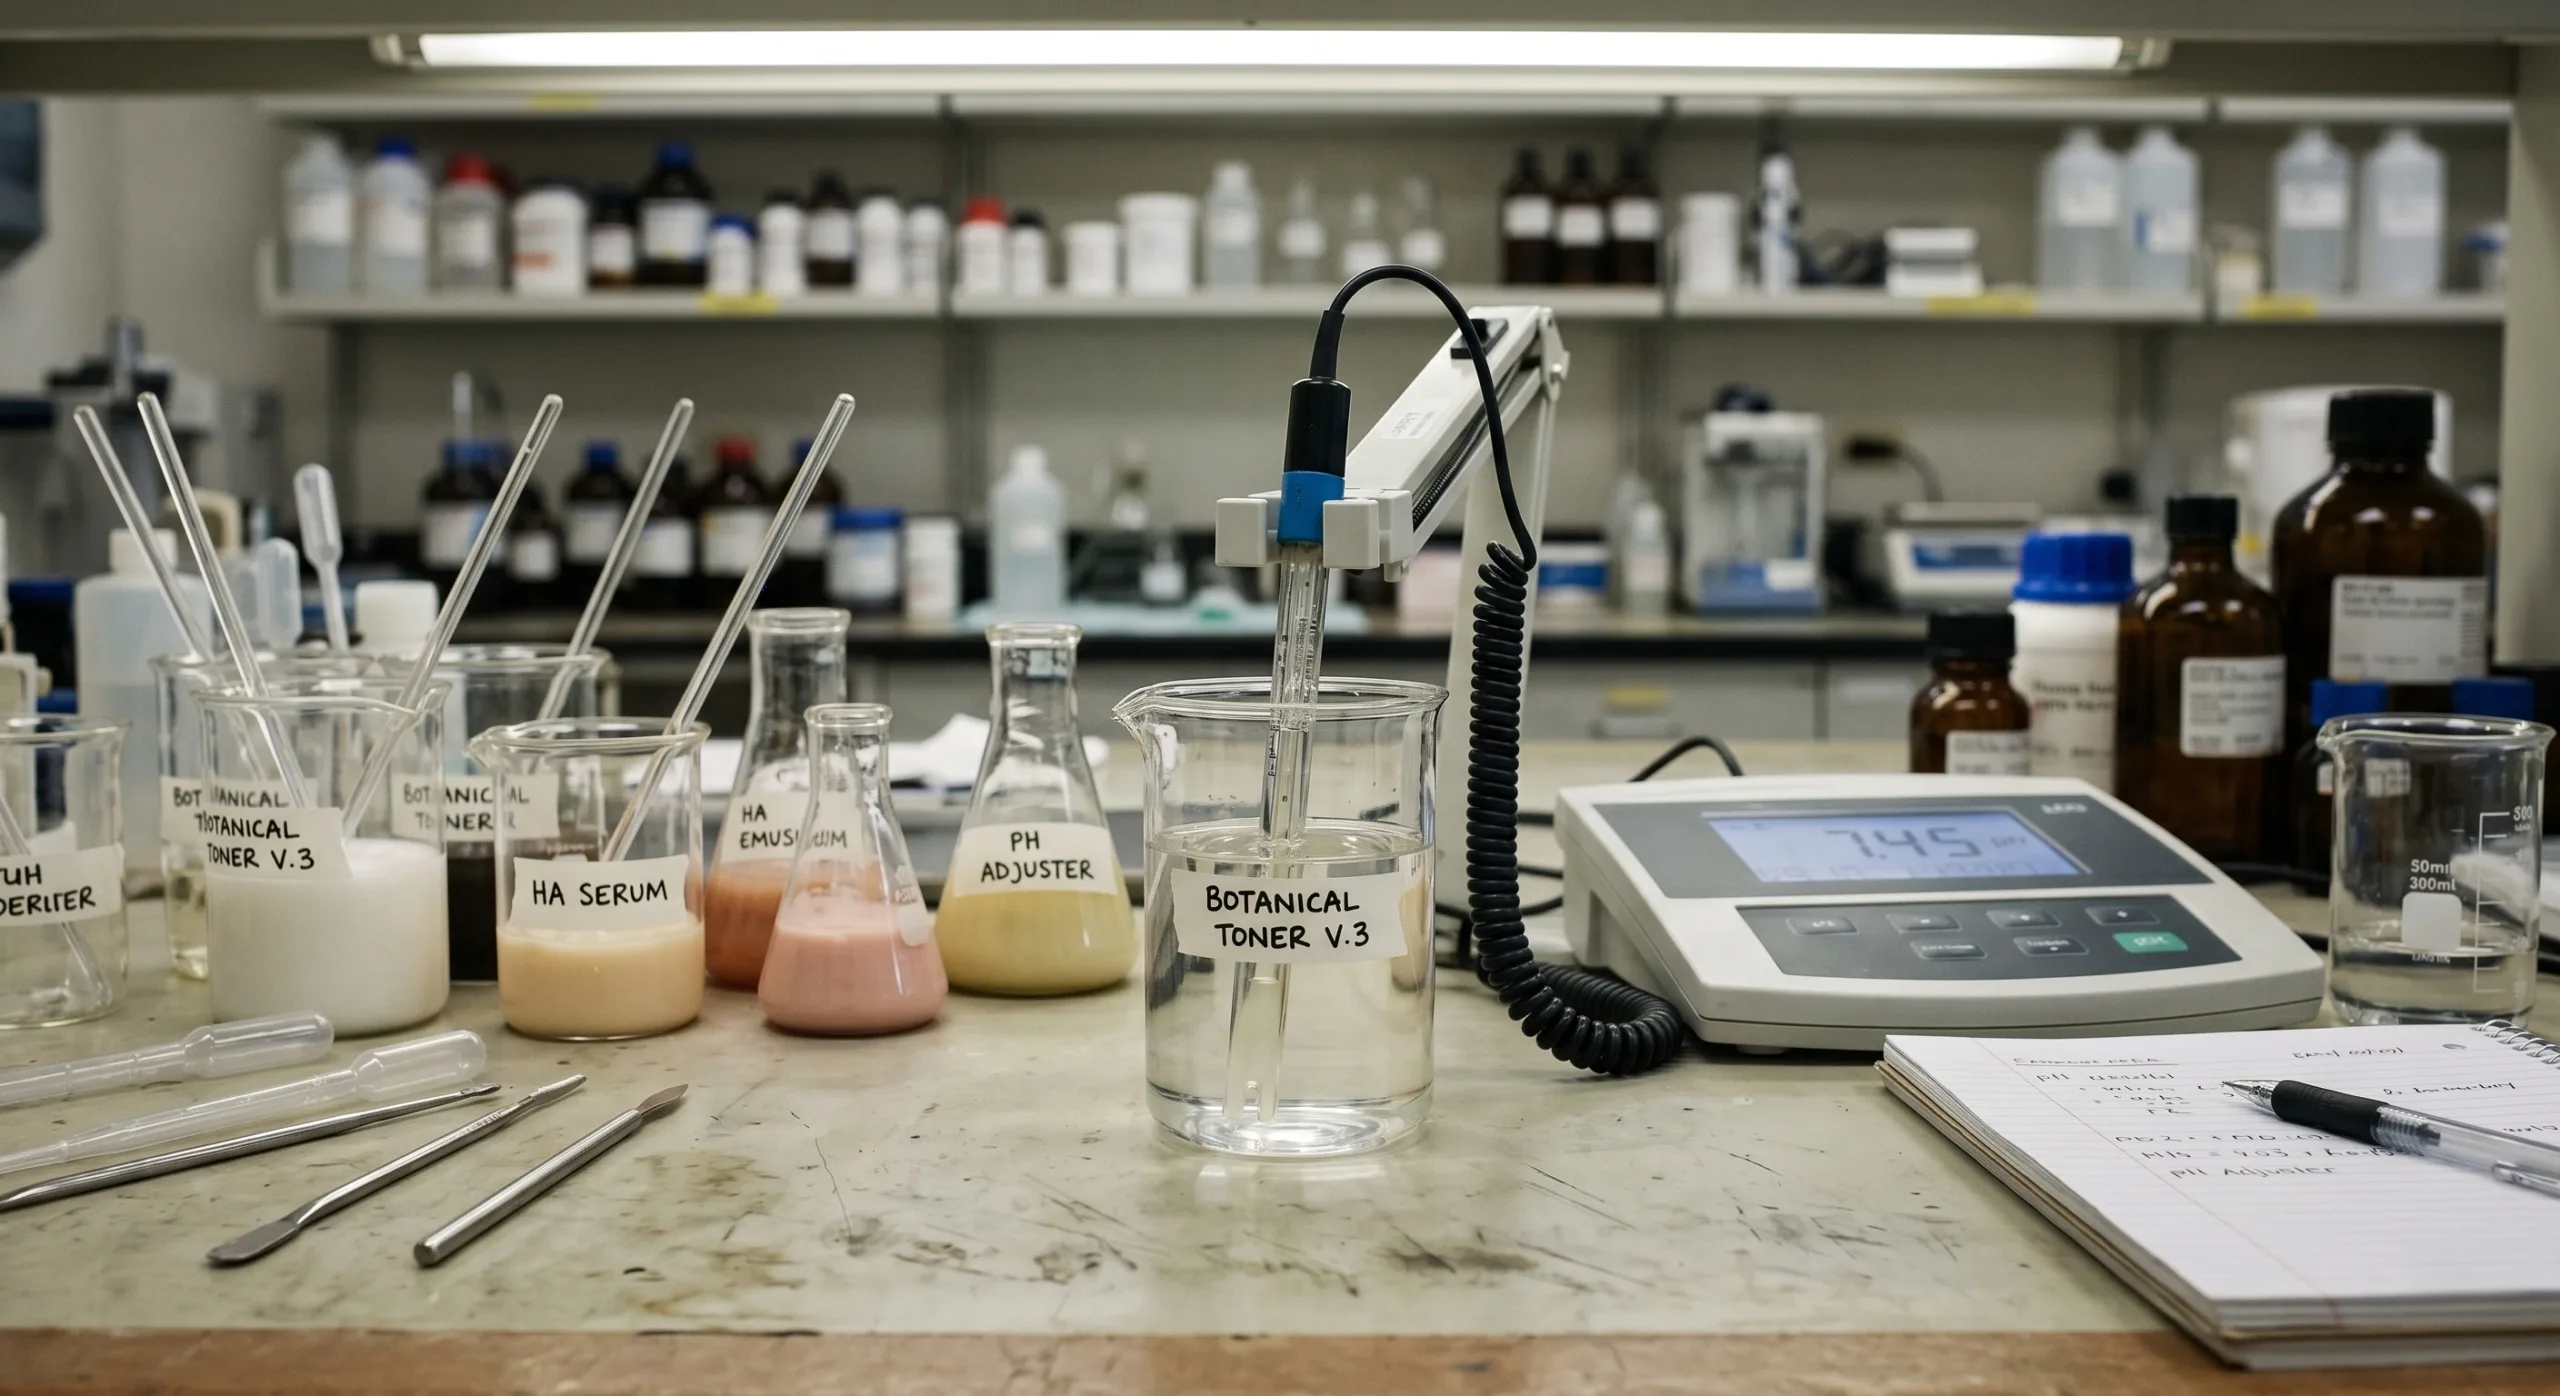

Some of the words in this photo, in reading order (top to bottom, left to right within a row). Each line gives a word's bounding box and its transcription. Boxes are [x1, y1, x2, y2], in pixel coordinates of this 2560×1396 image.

[742, 803, 767, 824] HA
[1010, 830, 1040, 852] PH
[1823, 826, 1983, 859] 7.45
[206, 842, 260, 869] TONER
[270, 847, 315, 871] V.3
[980, 858, 1095, 885] ADJUSTER
[2409, 876, 2457, 891] 300ml
[532, 879, 566, 906] HA
[579, 879, 668, 907] SERUM
[1205, 885, 1361, 914] BOTANICAL
[1213, 923, 1311, 950] TONER
[1324, 921, 1370, 949] V.3
